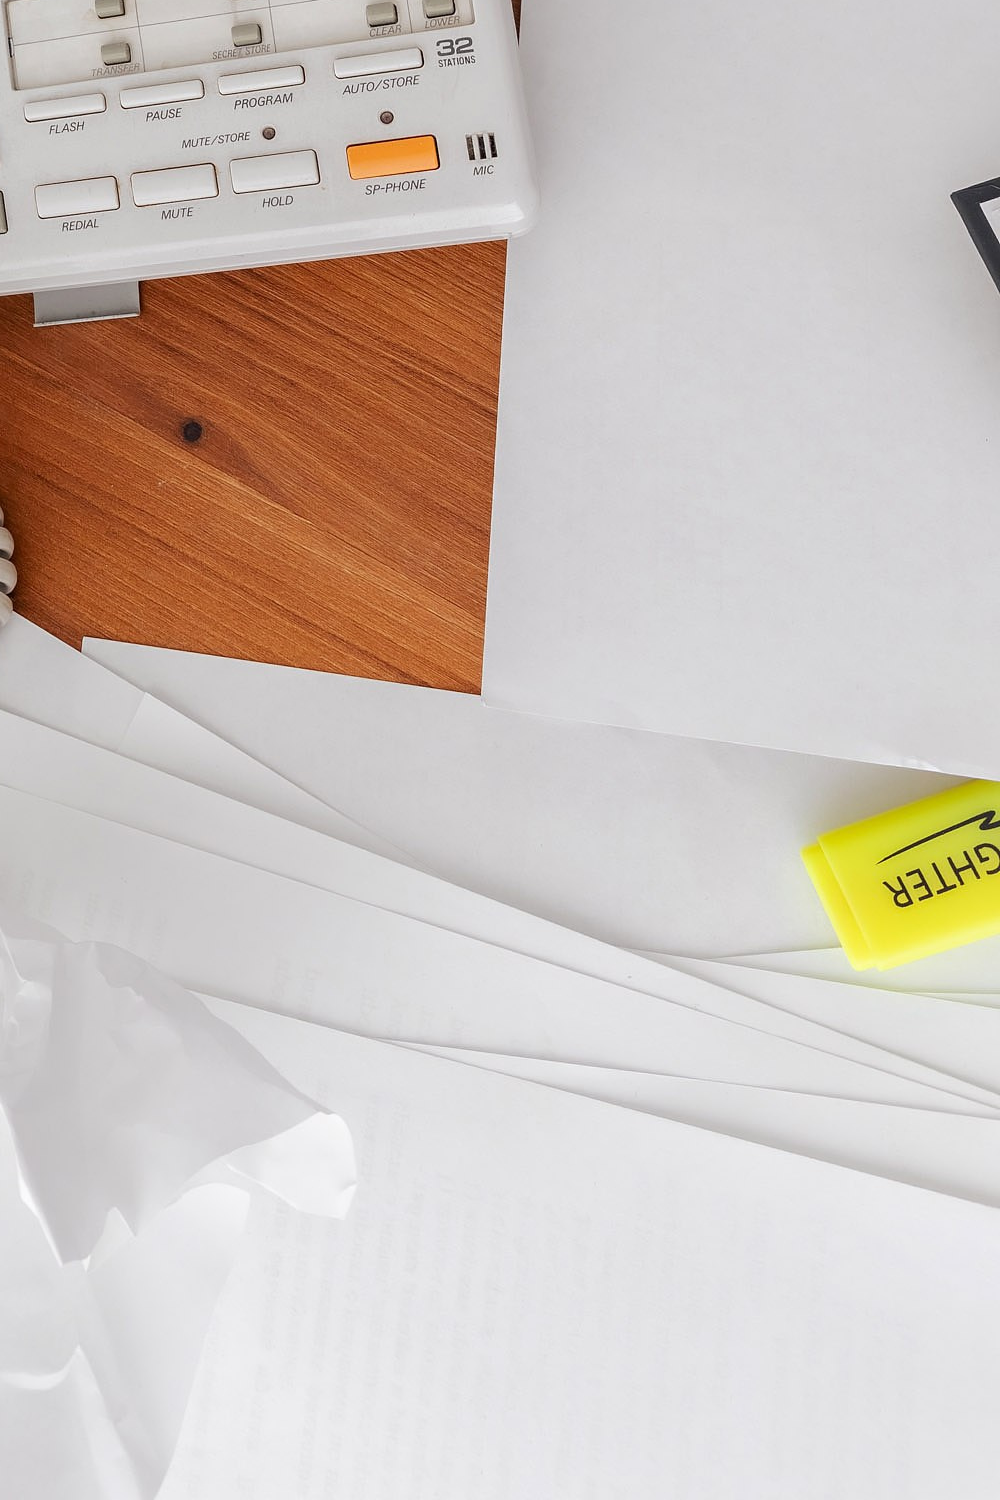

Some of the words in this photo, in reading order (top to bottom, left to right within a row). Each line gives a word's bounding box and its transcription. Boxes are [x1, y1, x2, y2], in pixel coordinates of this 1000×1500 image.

[424, 16, 460, 28] LOWER
[368, 25, 401, 37] CLEAR
[212, 47, 240, 60] SECRET
[242, 43, 271, 55] STORE
[436, 37, 474, 57] 32
[438, 55, 476, 68] STATIONS
[91, 62, 140, 77] TRANSFER
[343, 75, 420, 96] AUTO/STORE
[234, 93, 293, 110] PROGRAM
[146, 108, 182, 121] PAUSE
[49, 122, 85, 135] FLASH
[181, 131, 251, 149] MUTE/STORE
[473, 164, 494, 177] MIC
[365, 178, 426, 196] SP-PHONE
[262, 195, 294, 208] HOLD
[161, 207, 193, 220] MUTE
[62, 218, 99, 232] REDIAL
